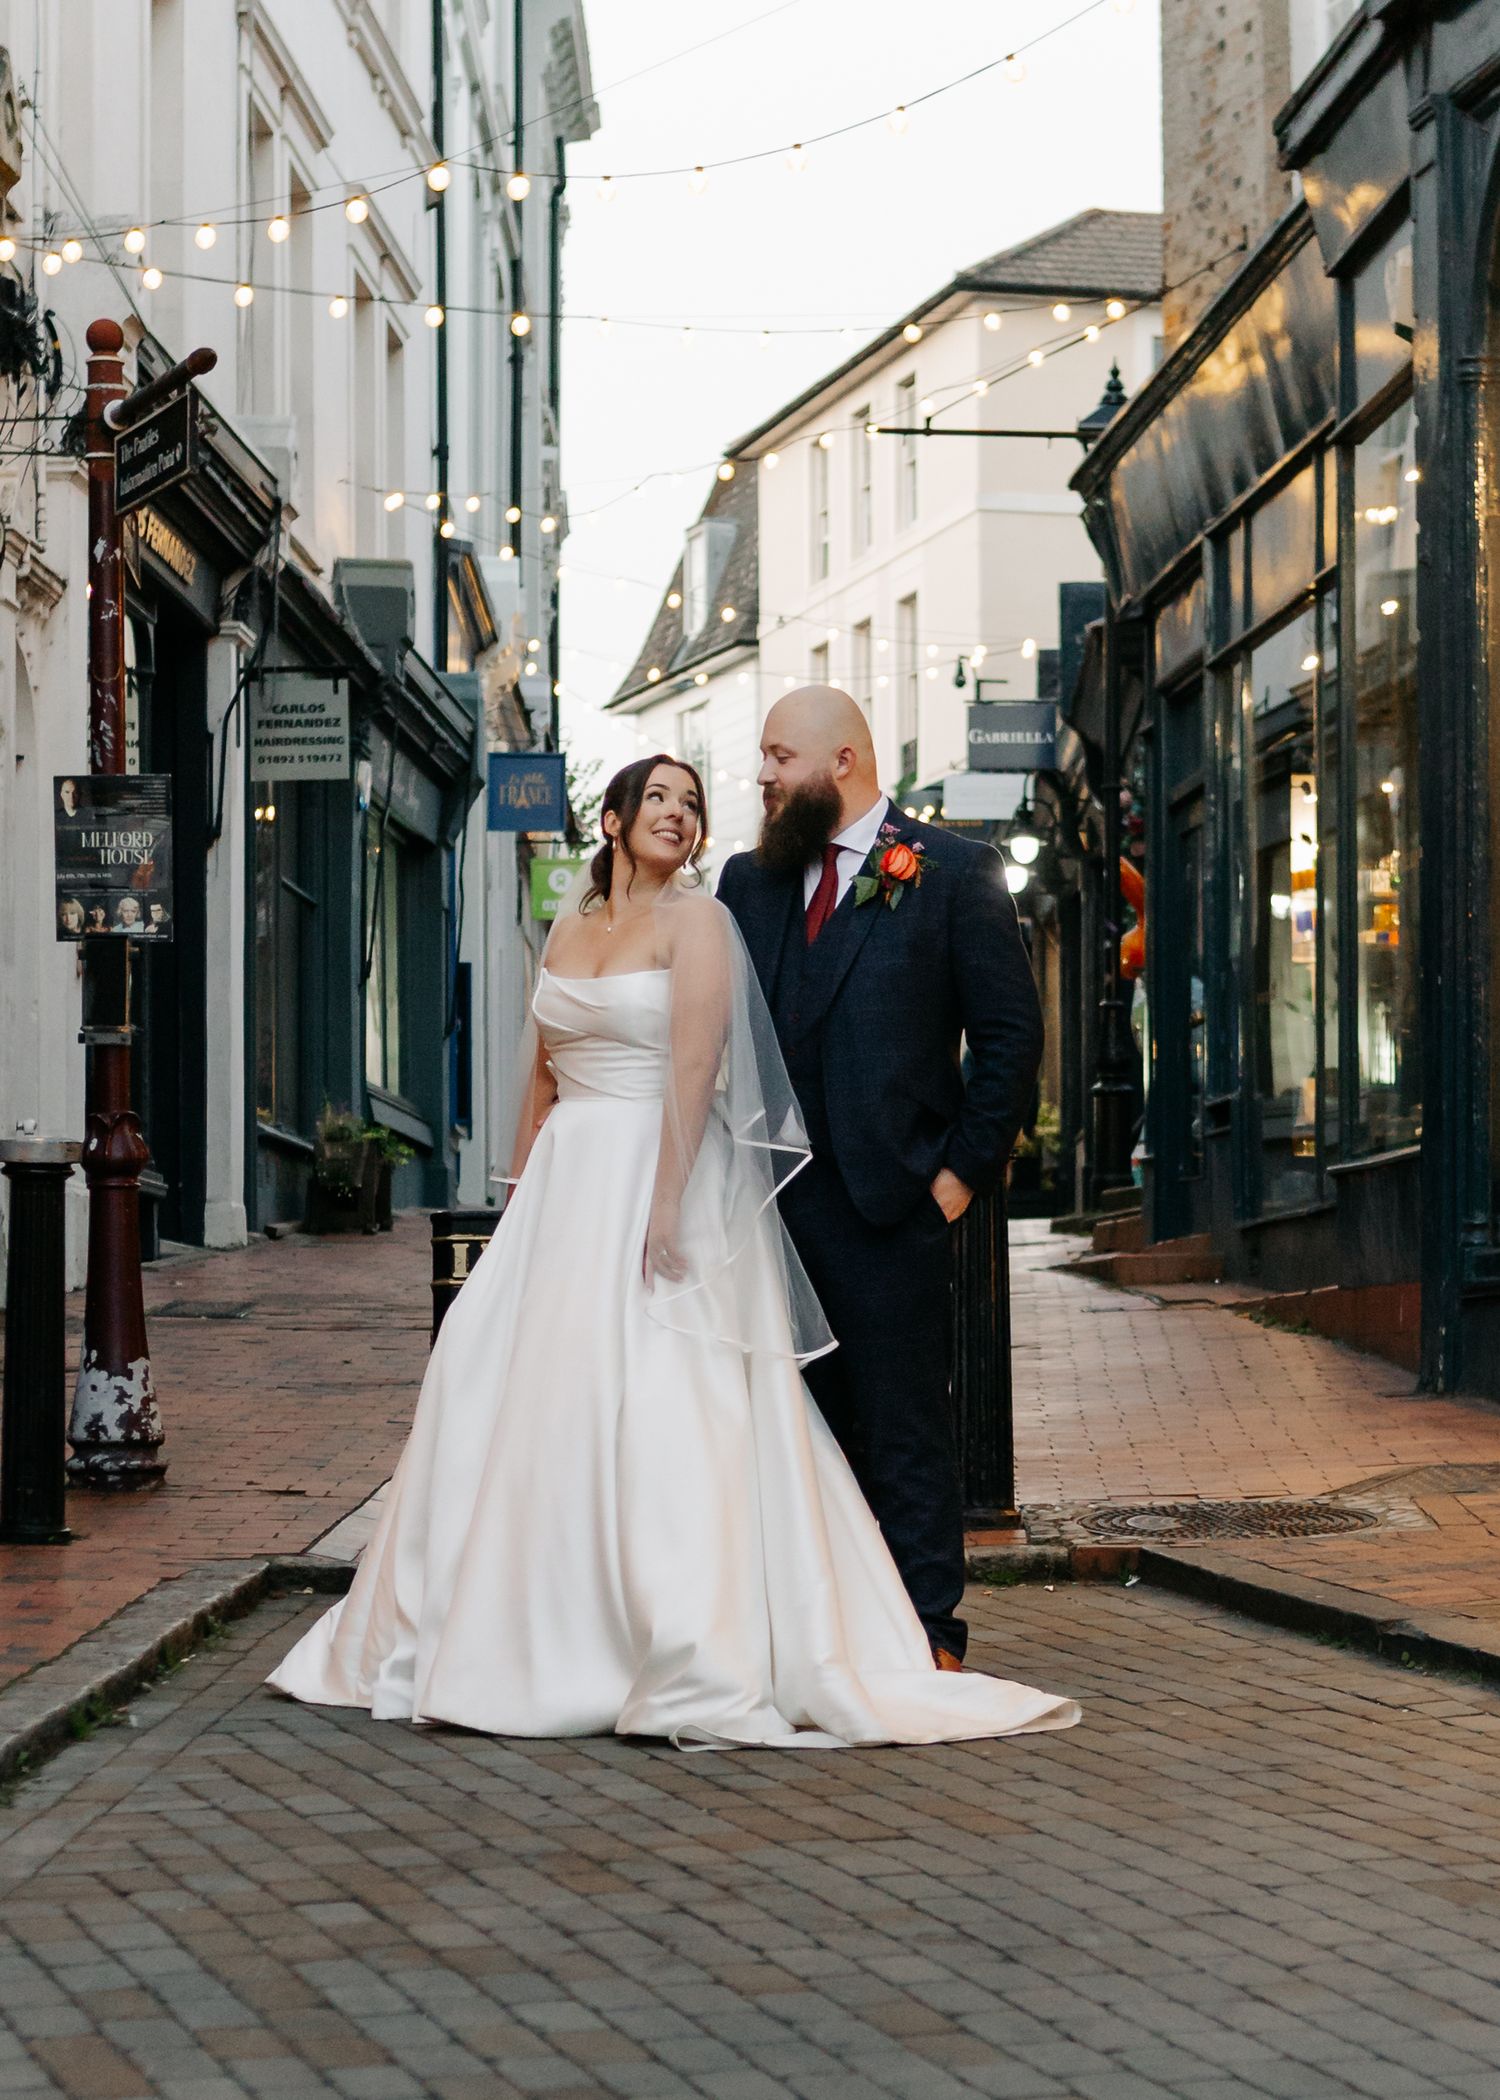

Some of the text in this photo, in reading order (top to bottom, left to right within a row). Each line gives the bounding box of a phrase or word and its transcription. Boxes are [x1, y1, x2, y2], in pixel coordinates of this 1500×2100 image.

[121, 443, 133, 464] The
[272, 703, 326, 714] CARLOS
[257, 717, 342, 730] FERNANDEZ
[254, 736, 345, 747] HAIRDRESSING
[81, 831, 153, 848] MELFORD
[100, 848, 153, 865] HOUSE
